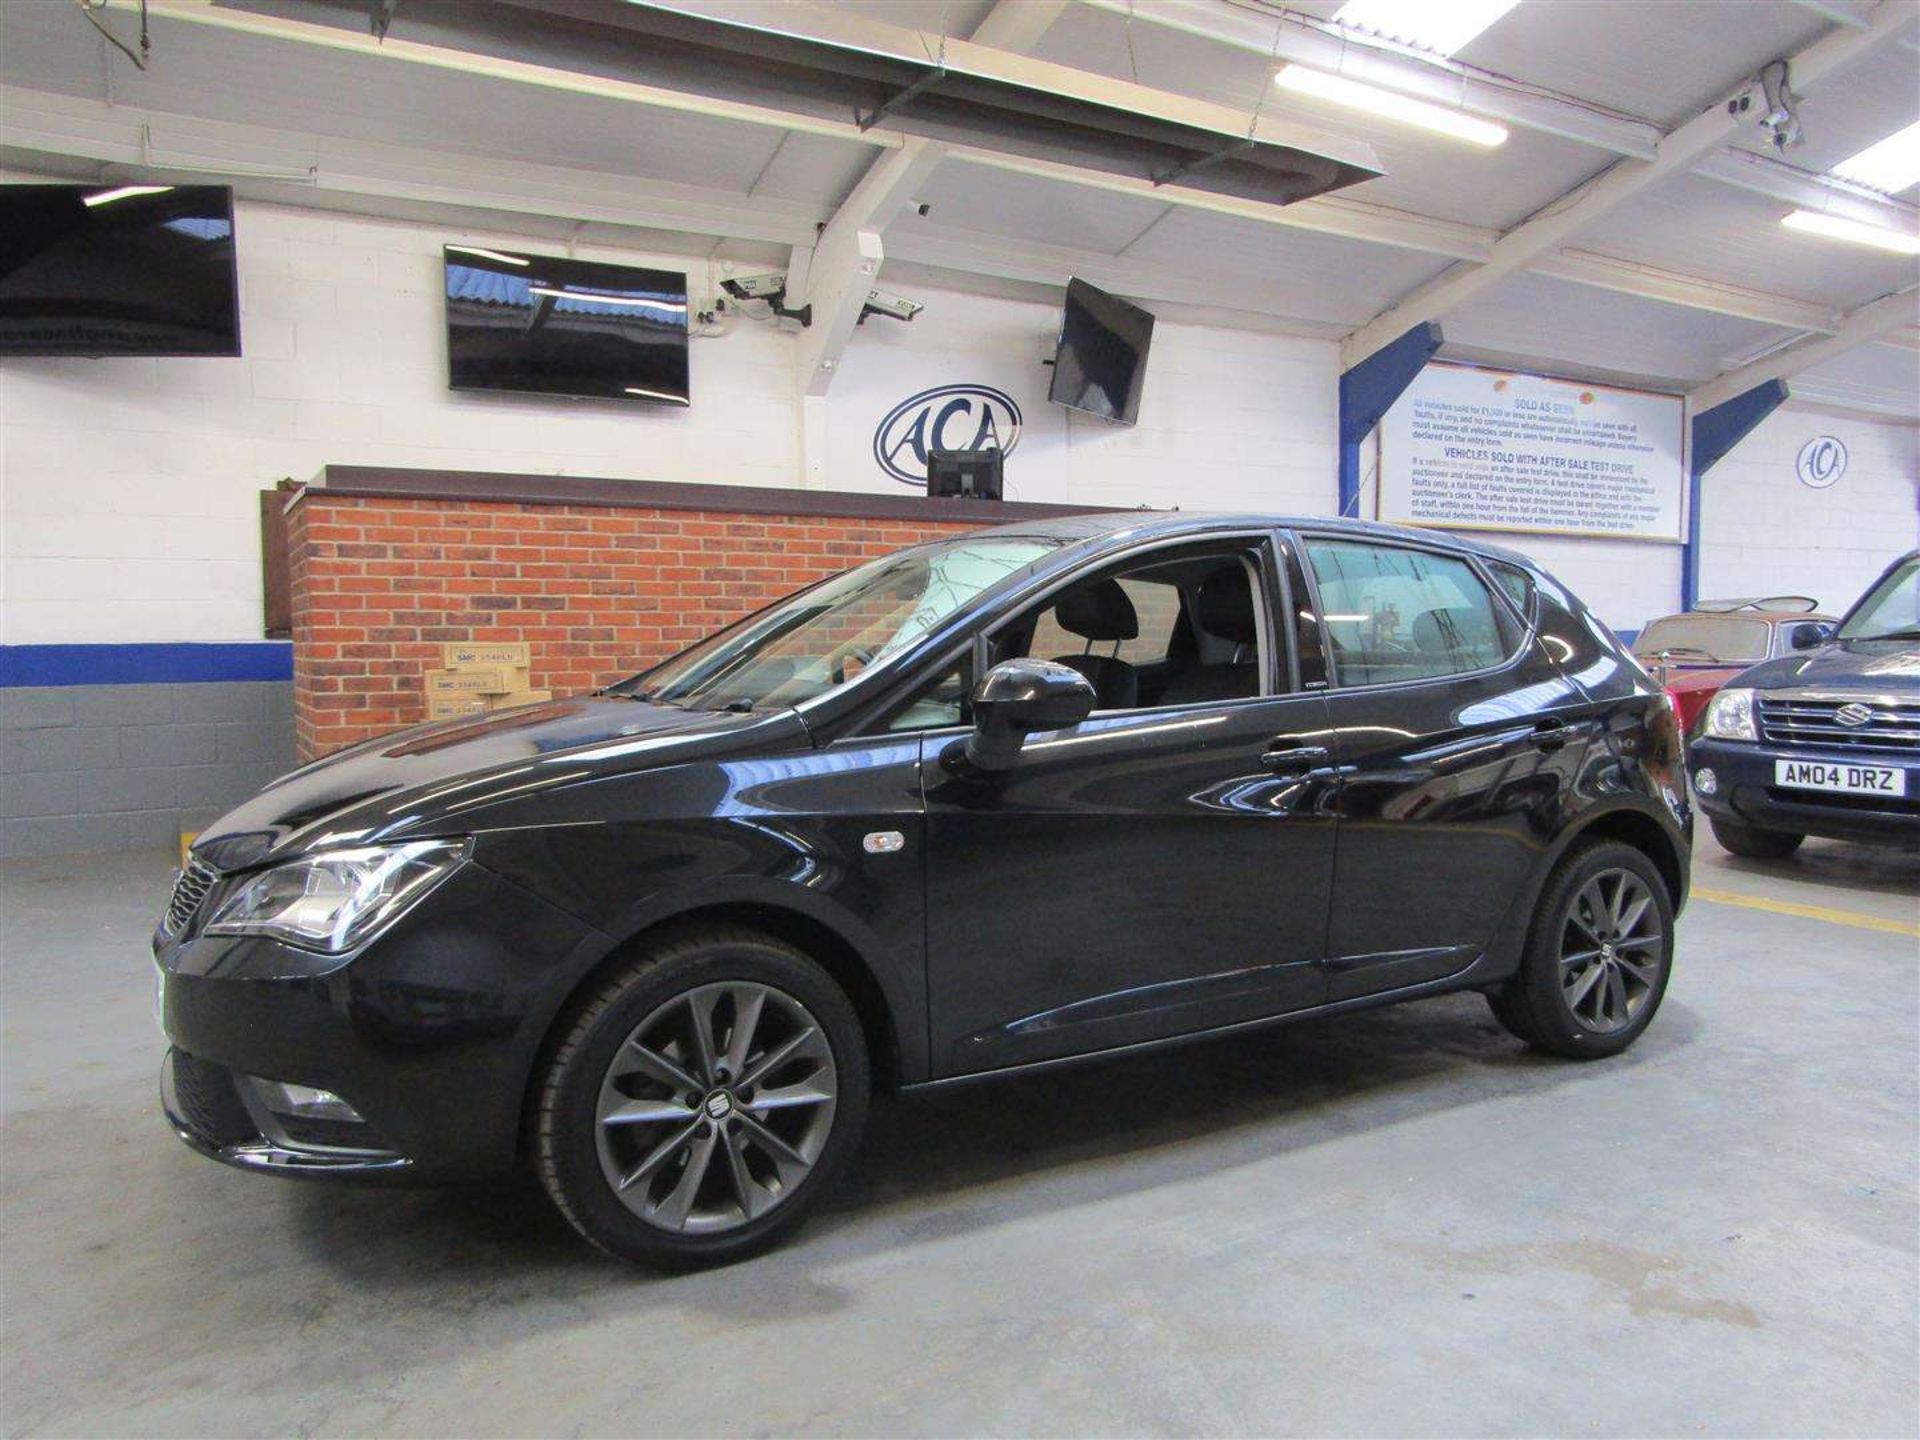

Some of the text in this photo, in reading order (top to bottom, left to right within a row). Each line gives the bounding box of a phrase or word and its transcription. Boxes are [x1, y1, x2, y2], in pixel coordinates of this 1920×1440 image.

[1514, 400, 1536, 410] SOLD
[888, 398, 1001, 466] ACA
[1444, 448, 1632, 473] VEHICLES SOLD WITH AFTER SALE TEST DRIVE
[1411, 478, 1431, 487] faults
[1456, 481, 1467, 490] full
[1468, 482, 1479, 490] list
[1786, 764, 1893, 790] AM04 DRZ
